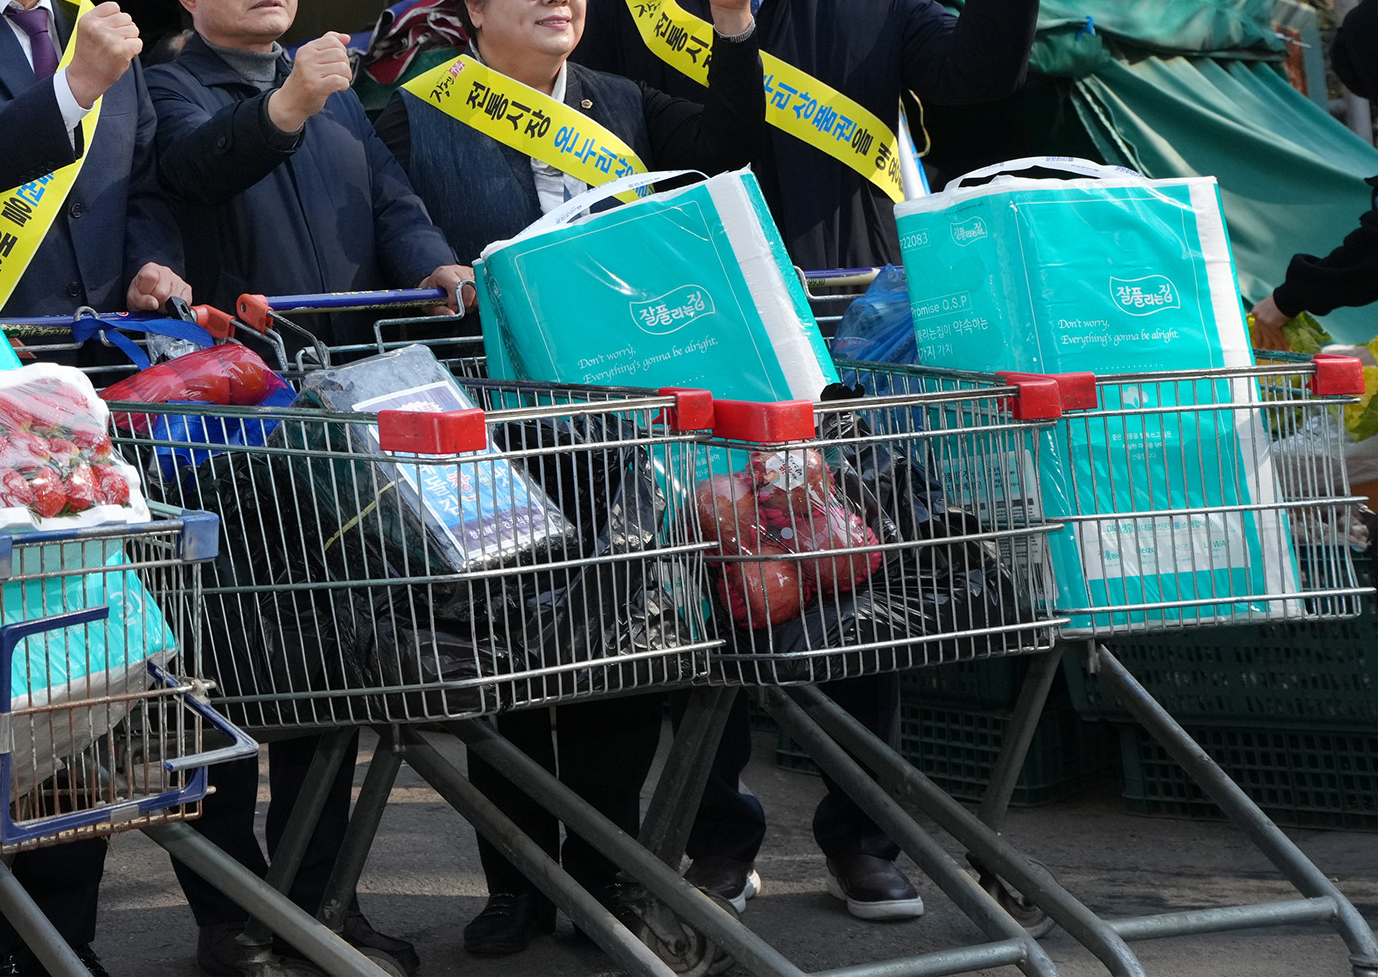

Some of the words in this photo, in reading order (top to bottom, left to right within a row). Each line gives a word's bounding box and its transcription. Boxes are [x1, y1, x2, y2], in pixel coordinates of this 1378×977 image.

[465, 81, 552, 139] 전통시장
[942, 295, 968, 312] Q.S.P
[1116, 284, 1173, 308] 잘풀리는집
[639, 290, 706, 327] 잘풀리는집
[952, 317, 989, 336] 약속하는
[1058, 318, 1082, 329] Don't
[1082, 320, 1110, 331] worry,
[1061, 331, 1112, 348] Everything's
[1113, 333, 1139, 346] gonna
[1141, 329, 1150, 340] be
[1151, 327, 1180, 344] alright.
[577, 353, 606, 370] Don't
[606, 345, 637, 362] worry,
[582, 360, 642, 385] Everything's
[642, 351, 672, 371] gonna
[672, 344, 683, 358] be
[685, 334, 719, 354] alright.
[937, 342, 954, 356] 가치
